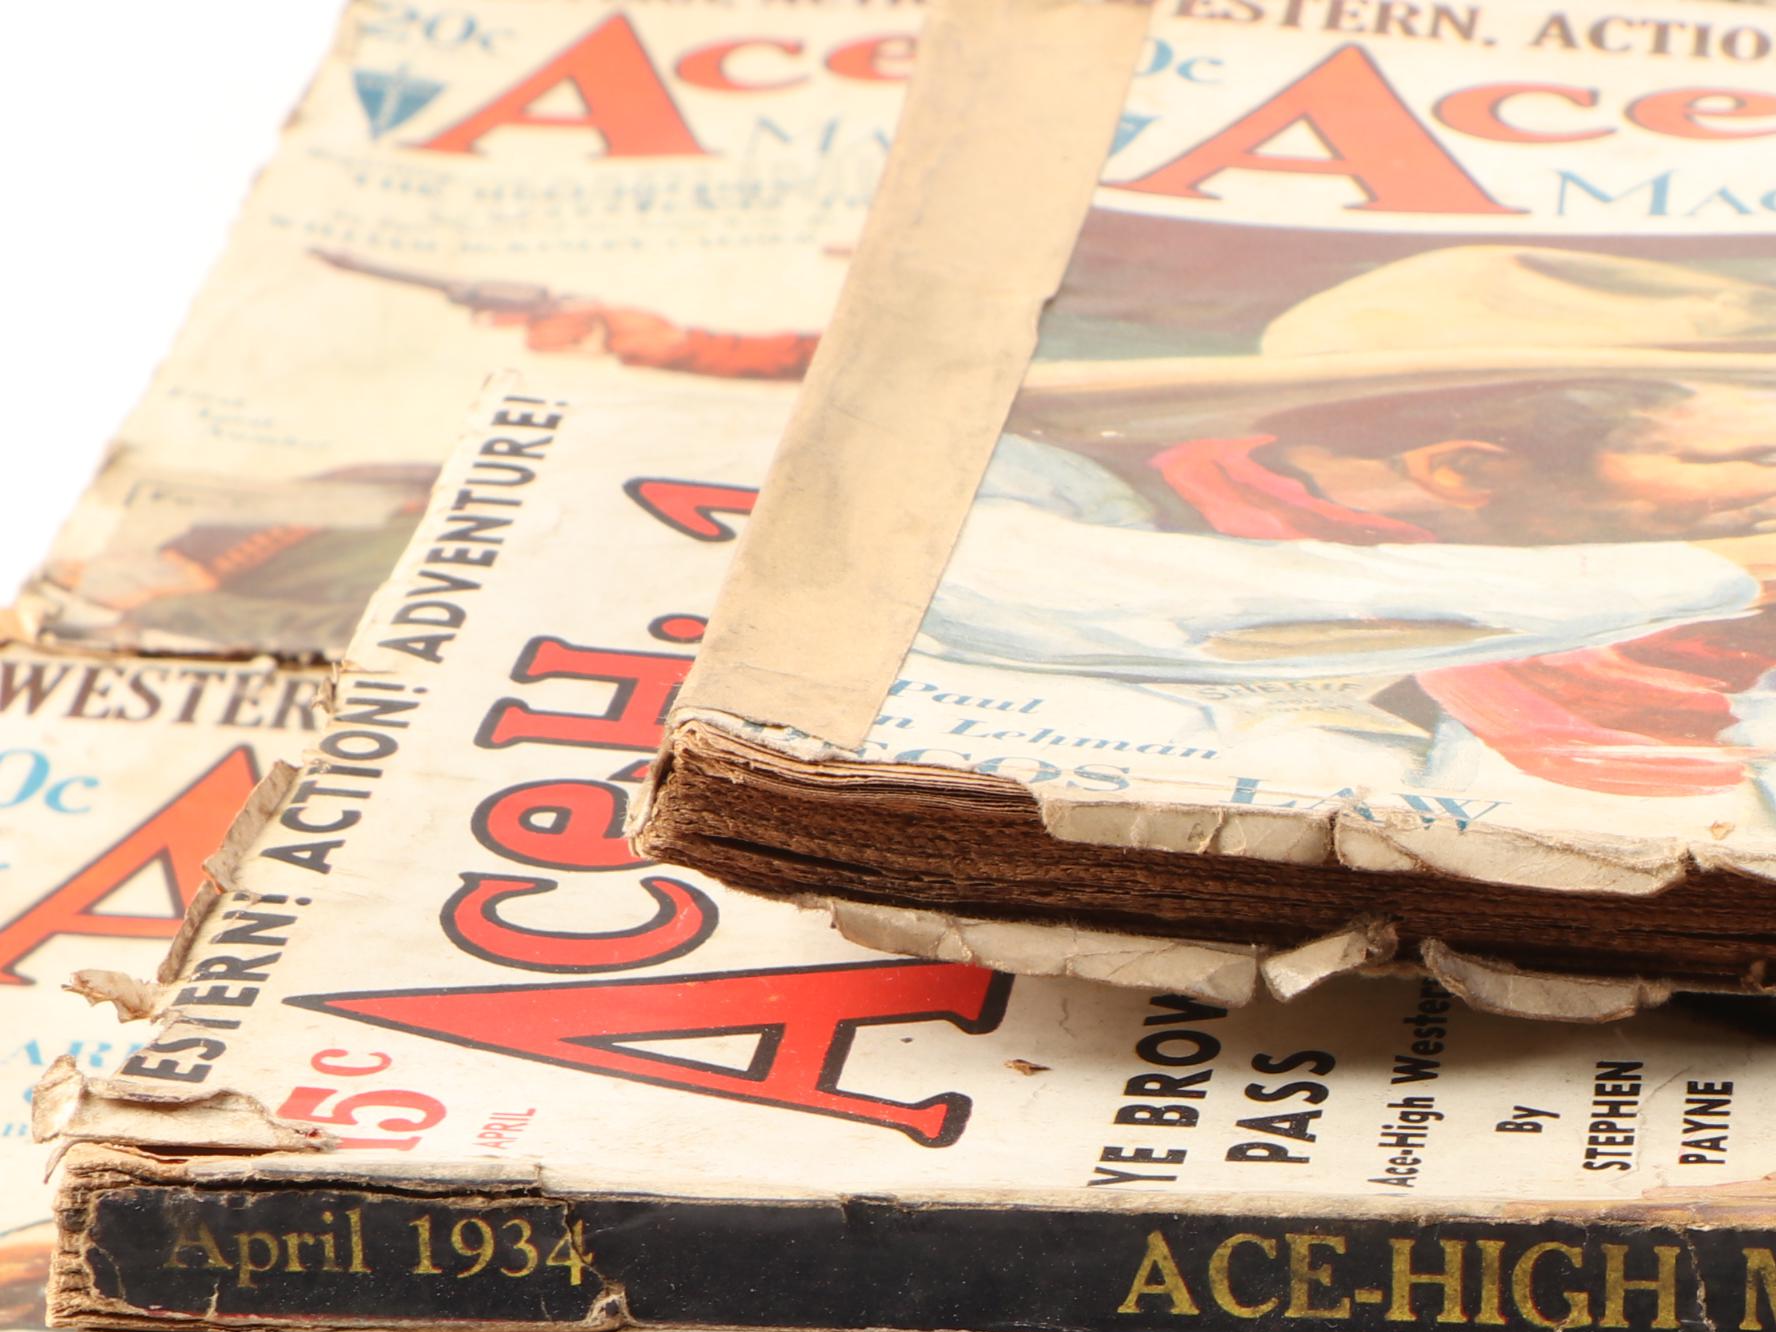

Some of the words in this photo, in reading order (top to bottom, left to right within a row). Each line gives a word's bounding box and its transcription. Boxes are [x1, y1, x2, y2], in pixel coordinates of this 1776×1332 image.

[259, 680, 428, 875] ACTION!
[377, 394, 570, 665] ADVENTURE!
[956, 715, 1222, 761] Lehman
[475, 1106, 537, 1150] APRIL
[1225, 1049, 1336, 1165] PASS
[1367, 1095, 1444, 1190] Ace-High
[1495, 1104, 1561, 1133] By
[1582, 1060, 1645, 1172] STEPHEN
[1679, 1079, 1734, 1165] PAYNE
[165, 1206, 370, 1289] April
[410, 1210, 597, 1288] 1934
[1117, 1230, 1683, 1330] ACE-HIGH
